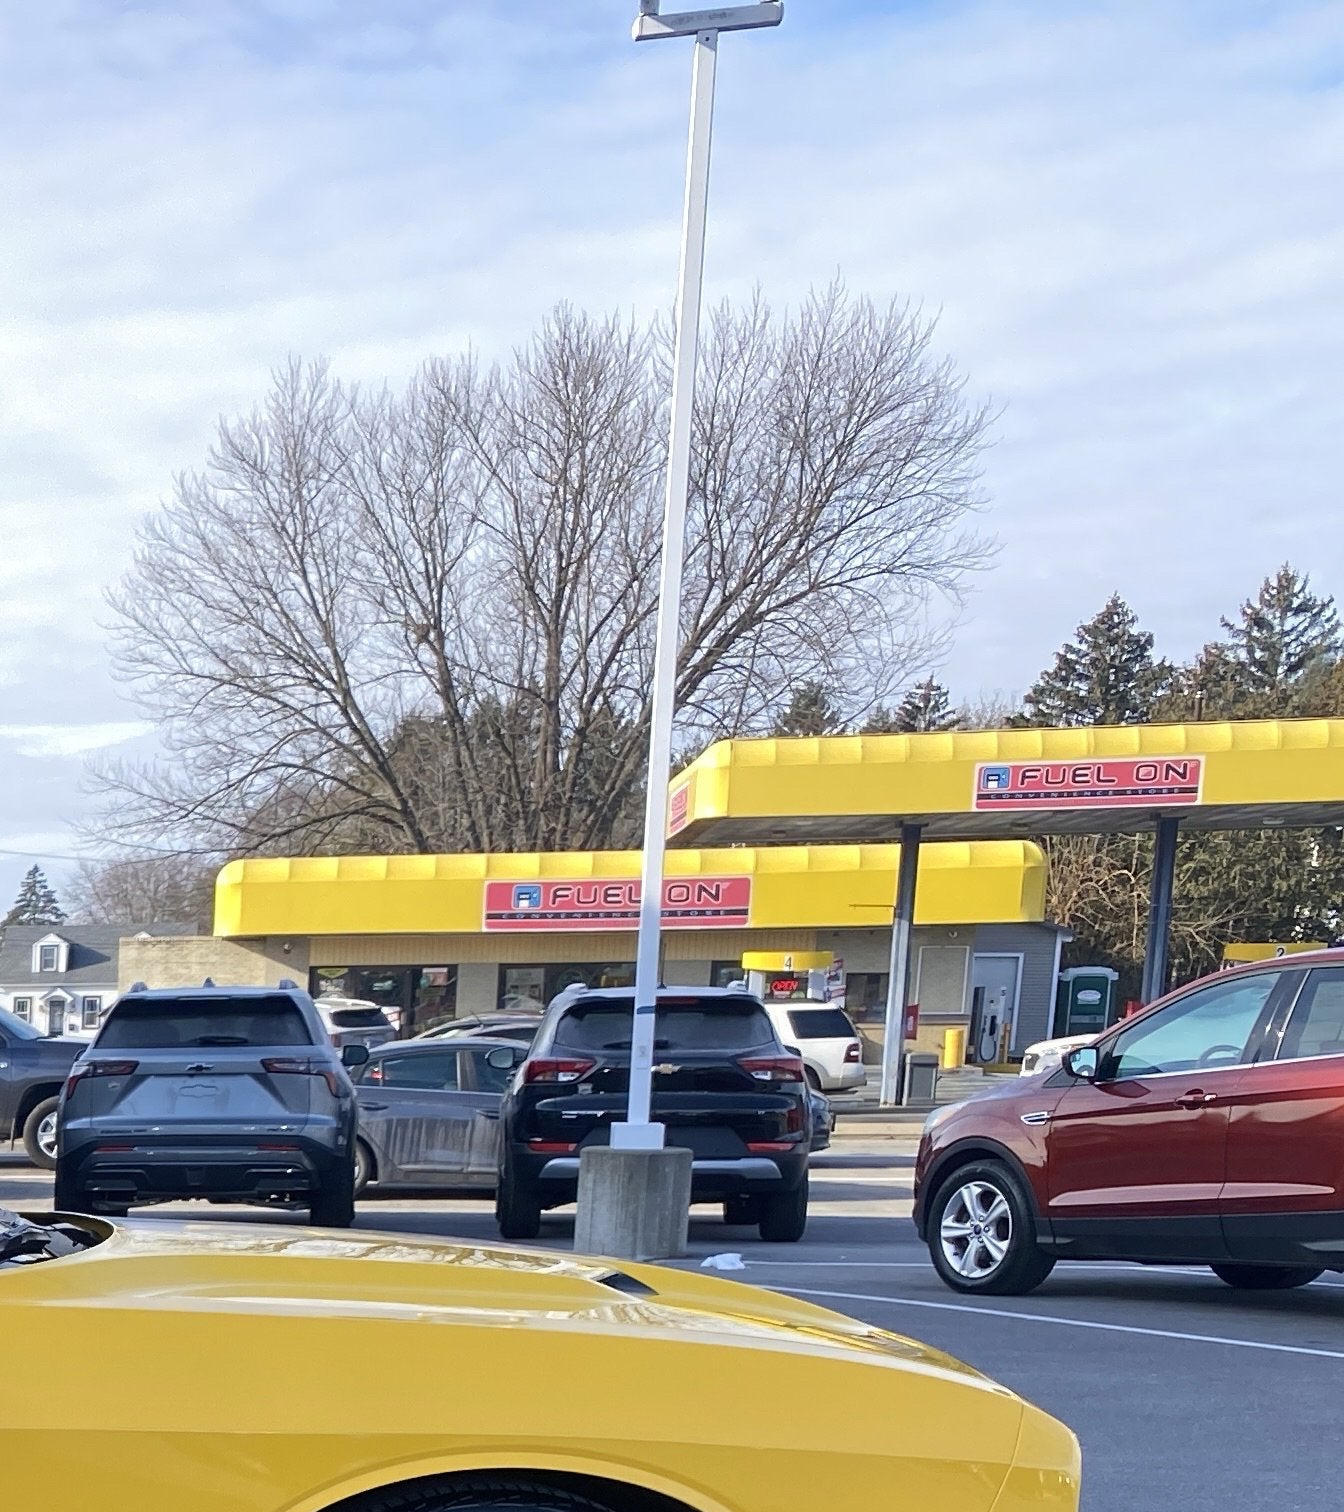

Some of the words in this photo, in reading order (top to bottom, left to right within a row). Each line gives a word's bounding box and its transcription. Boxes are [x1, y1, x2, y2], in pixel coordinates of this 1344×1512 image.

[1019, 766, 1116, 786] FUEL
[1135, 763, 1188, 781] ON
[990, 790, 1112, 799] CONVENIENCE
[550, 884, 641, 906] FUEL
[666, 883, 722, 904] ON
[502, 911, 641, 919] CONVENIENC
[784, 957, 792, 968] 4
